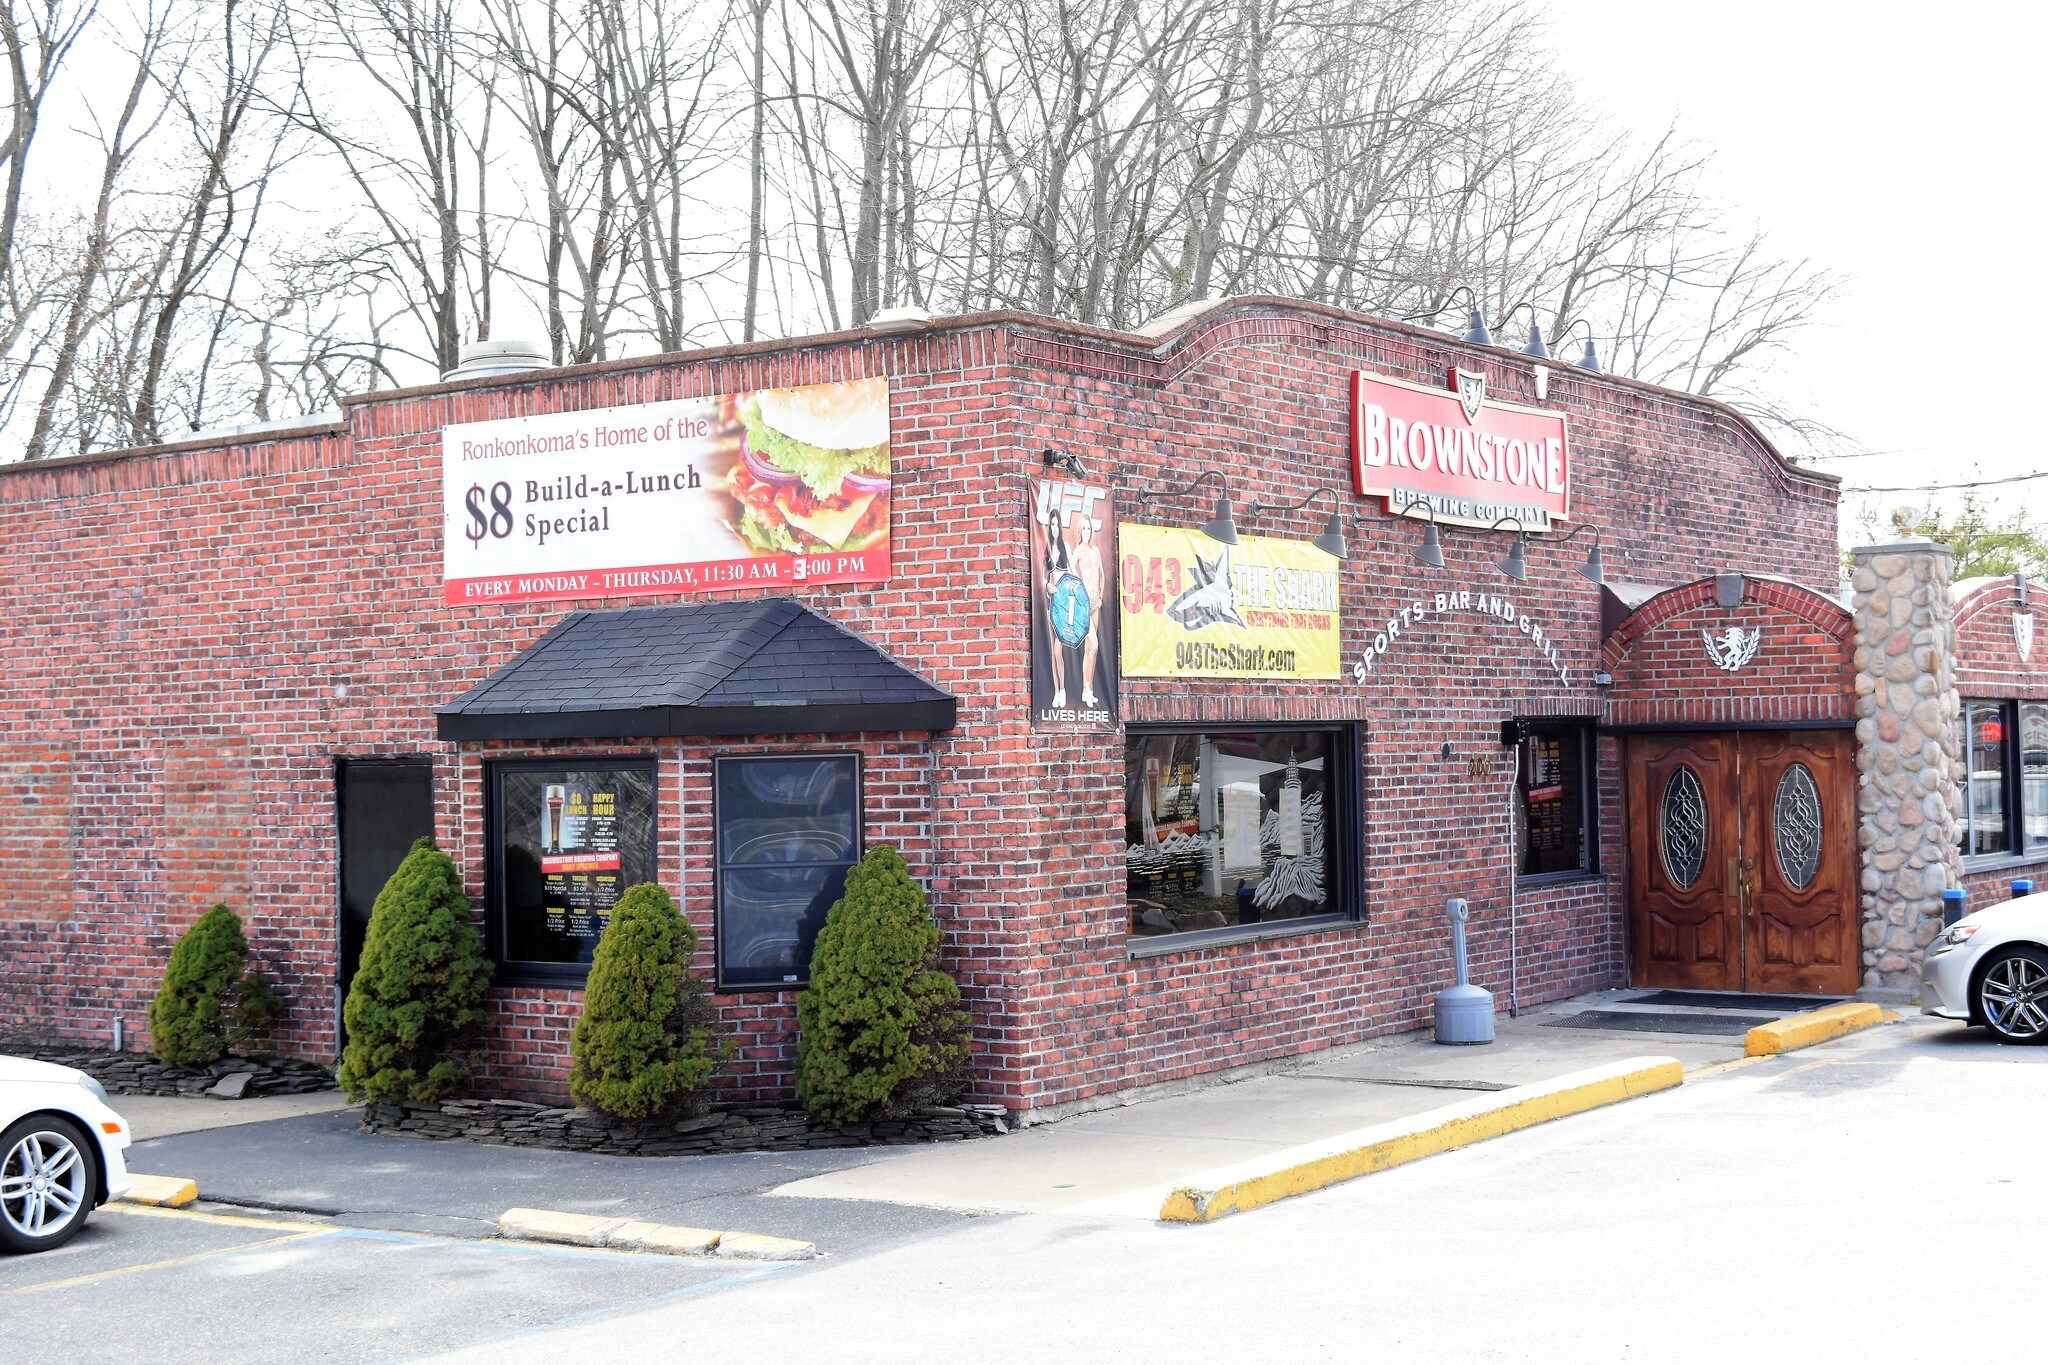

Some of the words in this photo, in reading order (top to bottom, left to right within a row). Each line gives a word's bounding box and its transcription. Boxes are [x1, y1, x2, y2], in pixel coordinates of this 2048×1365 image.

[462, 428, 589, 461] Ronkonkoma's
[594, 424, 648, 448] Home
[653, 418, 673, 441] of
[677, 416, 708, 439] the
[525, 464, 702, 503] Build-a-Lunch
[465, 481, 514, 550] $8
[1036, 479, 1106, 532] UFC
[1394, 487, 1470, 517] BREWING
[1475, 503, 1543, 523] COMPANY
[525, 506, 610, 546] Special
[465, 581, 513, 597] EVERY
[517, 575, 589, 594] MONDAY
[602, 565, 699, 589] THURSDAY,
[704, 564, 744, 582] 11:30
[749, 562, 777, 579] AM
[837, 556, 865, 574] PM
[1233, 564, 1270, 608] THE
[1273, 567, 1339, 613] SHARK
[1176, 641, 1296, 672] 943TheShark.com
[1353, 602, 1424, 685] SPORTS
[1434, 591, 1470, 614] BAR
[1476, 594, 1515, 622] AND
[1519, 615, 1569, 688] GRILL
[1041, 709, 1076, 722] LIVES
[1077, 710, 1110, 722] HERE
